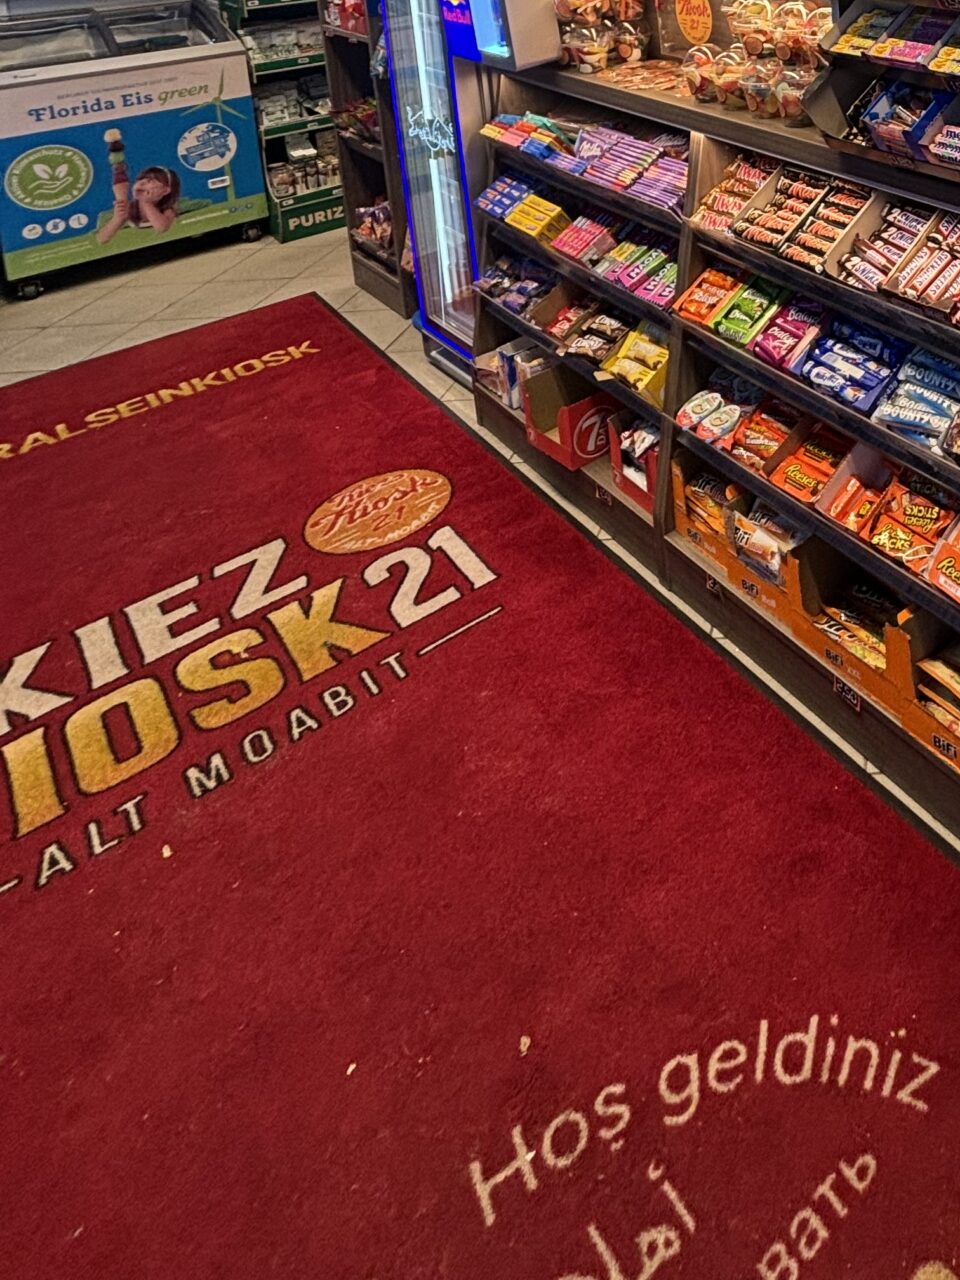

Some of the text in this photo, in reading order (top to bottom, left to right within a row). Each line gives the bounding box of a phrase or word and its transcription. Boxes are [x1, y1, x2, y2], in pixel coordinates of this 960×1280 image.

[27, 96, 117, 122] Florida
[121, 91, 155, 108] Eis
[157, 82, 210, 106] green
[288, 205, 345, 231] PURIZ
[907, 364, 957, 392] BOUNTY
[886, 405, 933, 425] BOUNTY
[310, 475, 443, 542] Kiosk
[371, 504, 405, 532] 21
[362, 524, 499, 630] 21
[0, 537, 308, 735] KIEZ
[824, 648, 844, 667] BiFi
[932, 734, 959, 760] BiFi
[37, 650, 410, 887] ALT MOABIT
[469, 1014, 941, 1227] Hoş geldiniz
